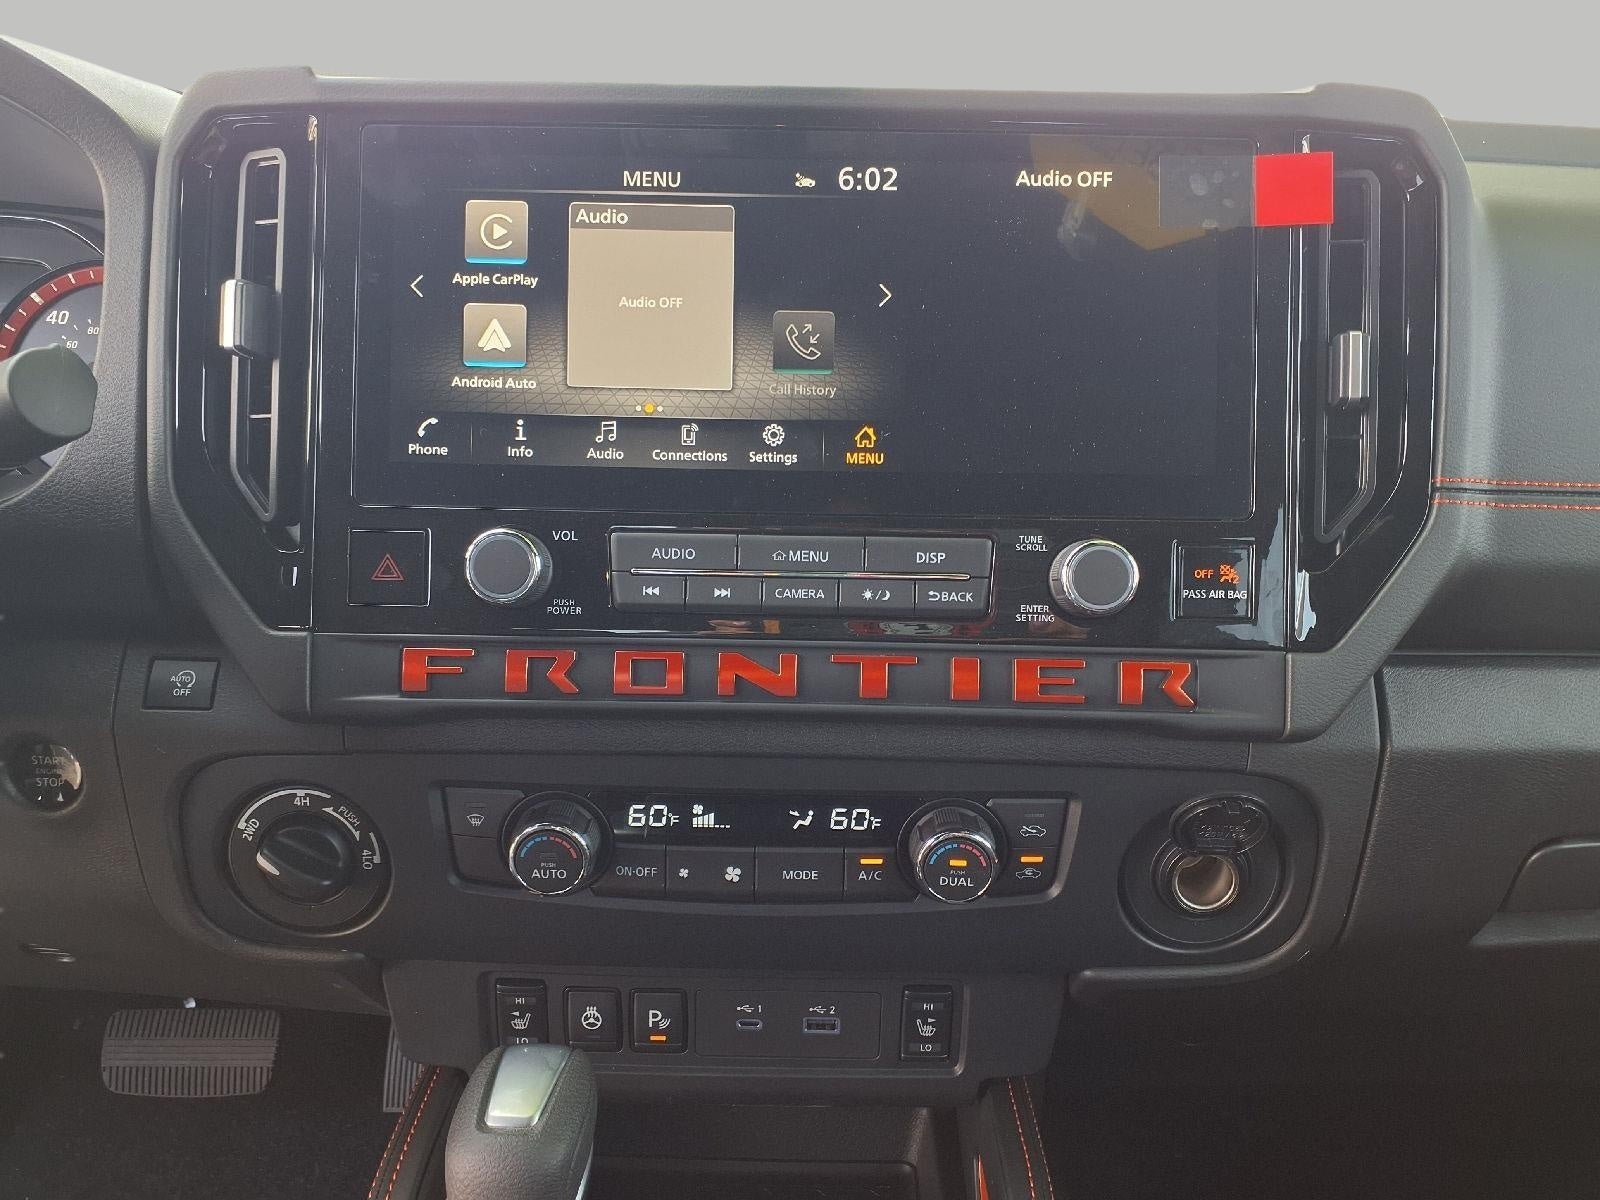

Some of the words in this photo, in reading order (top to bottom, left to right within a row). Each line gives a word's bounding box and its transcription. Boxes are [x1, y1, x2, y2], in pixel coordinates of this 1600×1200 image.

[622, 171, 681, 188] MENU
[837, 166, 898, 191] 6:02
[1015, 170, 1072, 188] Audio
[1077, 171, 1113, 188] OFF
[575, 208, 629, 225] Audio
[452, 272, 490, 288] Apple
[492, 273, 538, 289] CarPlay
[619, 296, 655, 309] Audio
[660, 297, 683, 309] OFF
[46, 310, 69, 324] 40
[87, 326, 100, 335] 80
[66, 340, 78, 349] 60
[451, 376, 501, 389] Android
[505, 377, 537, 389] Auto
[769, 384, 790, 396] Call
[795, 384, 837, 398] History
[408, 443, 448, 456] Phone
[507, 446, 534, 458] Info
[587, 447, 625, 460] Audio
[652, 448, 728, 463] Connections
[749, 451, 798, 465] Settings
[846, 452, 884, 466] MENU
[552, 530, 578, 541] VOL
[1018, 535, 1043, 544] TUNE
[1015, 543, 1048, 551] SCROLL
[651, 547, 696, 560] AUDIO
[788, 550, 829, 563] MENU
[916, 551, 946, 564] DISP
[1194, 569, 1214, 579] OFF
[775, 587, 825, 600] CAMERA
[941, 591, 973, 603] BACK
[1183, 589, 1207, 599] PASS
[1208, 590, 1225, 599] AIR
[1227, 590, 1248, 600] BAG
[547, 606, 582, 615] POWER
[1020, 605, 1049, 614] ENTER
[1015, 614, 1055, 623] SETTING
[170, 674, 191, 684] AUTO
[400, 647, 1197, 708] FRONTIER
[173, 688, 191, 696] OFF
[31, 755, 65, 766] START
[294, 797, 310, 807] 4H
[338, 805, 361, 827] PUSH
[242, 818, 260, 842] 2WD
[362, 849, 373, 870] 4LO
[531, 868, 567, 880] AUTO
[782, 869, 819, 881] MODE
[858, 869, 882, 882] A/C
[939, 876, 975, 887] DUAL
[515, 997, 525, 1005] HI
[923, 1003, 934, 1011] HI
[757, 1004, 763, 1013] 1
[829, 1006, 836, 1015] 2
[920, 1044, 932, 1052] LO
